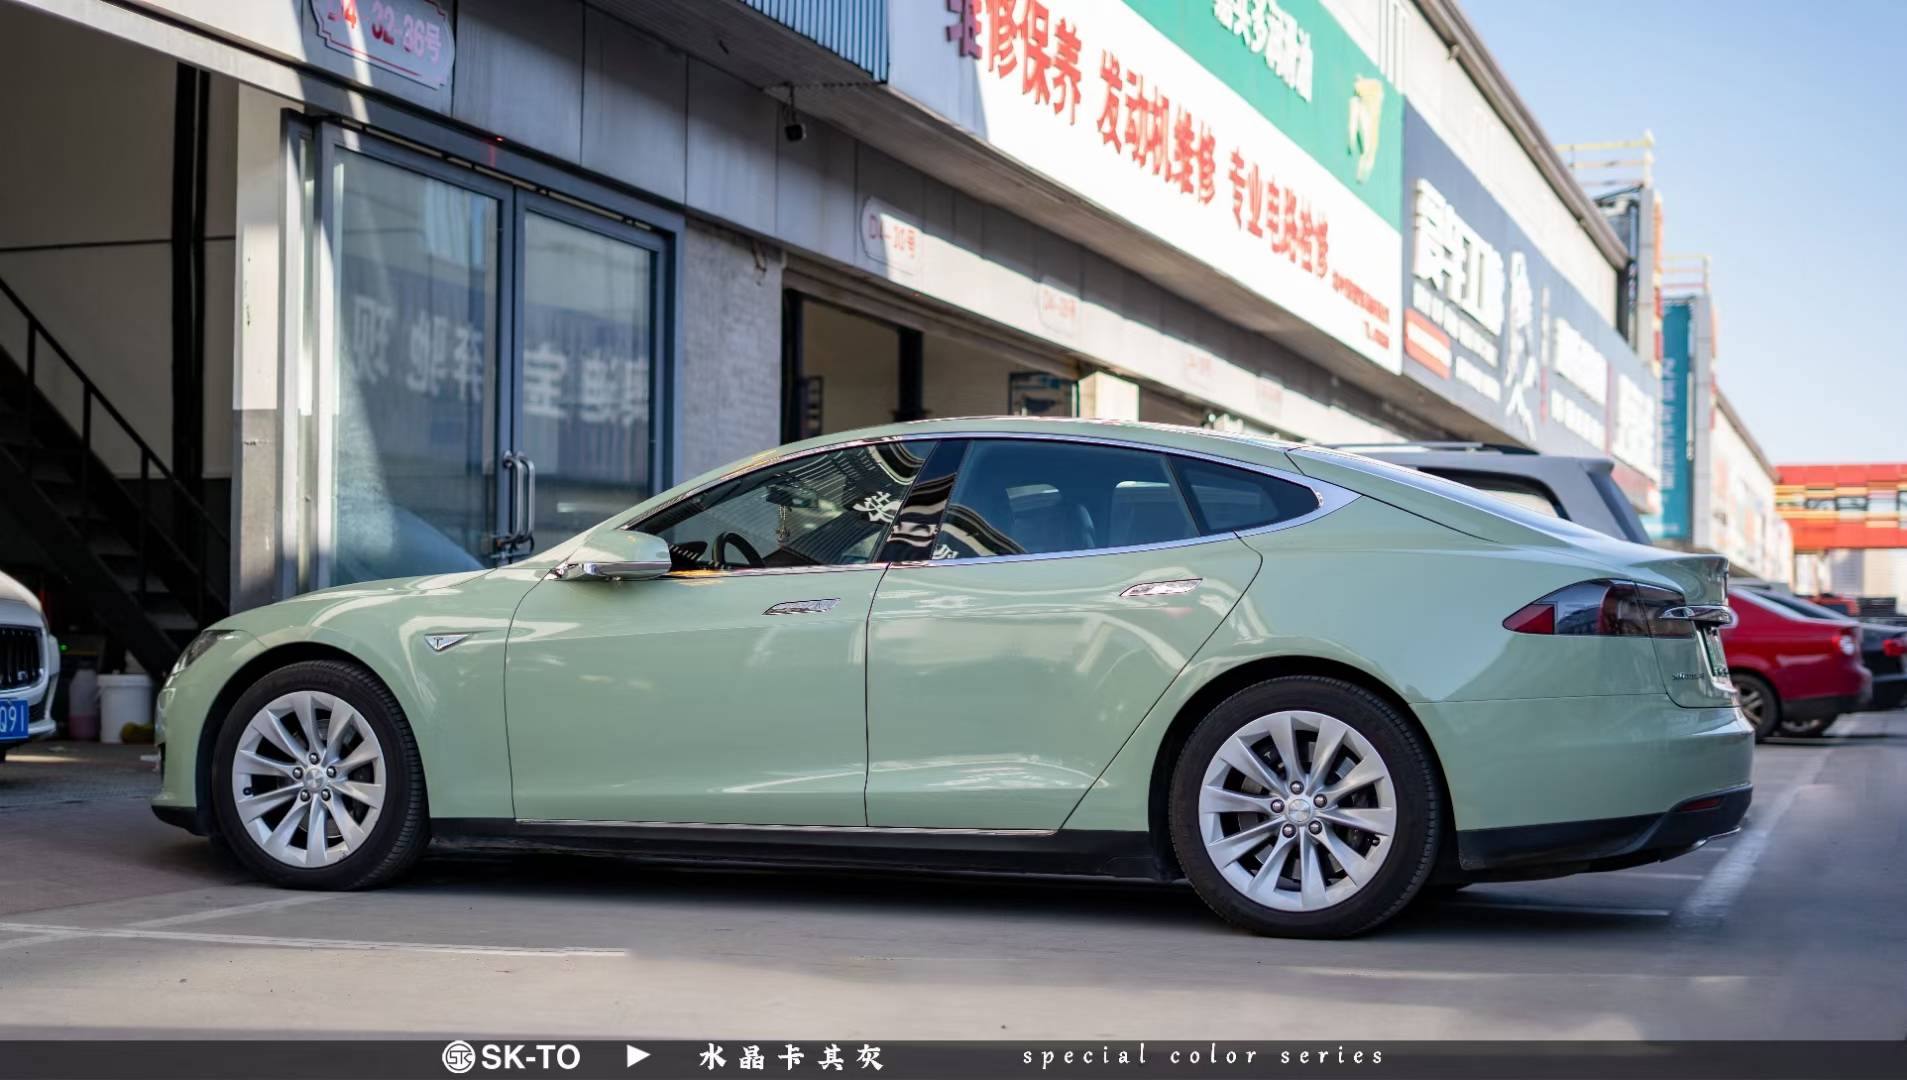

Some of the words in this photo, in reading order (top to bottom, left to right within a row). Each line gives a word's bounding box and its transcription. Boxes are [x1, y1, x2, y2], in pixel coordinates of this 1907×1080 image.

[1097, 49, 1216, 206] 发动机维修
